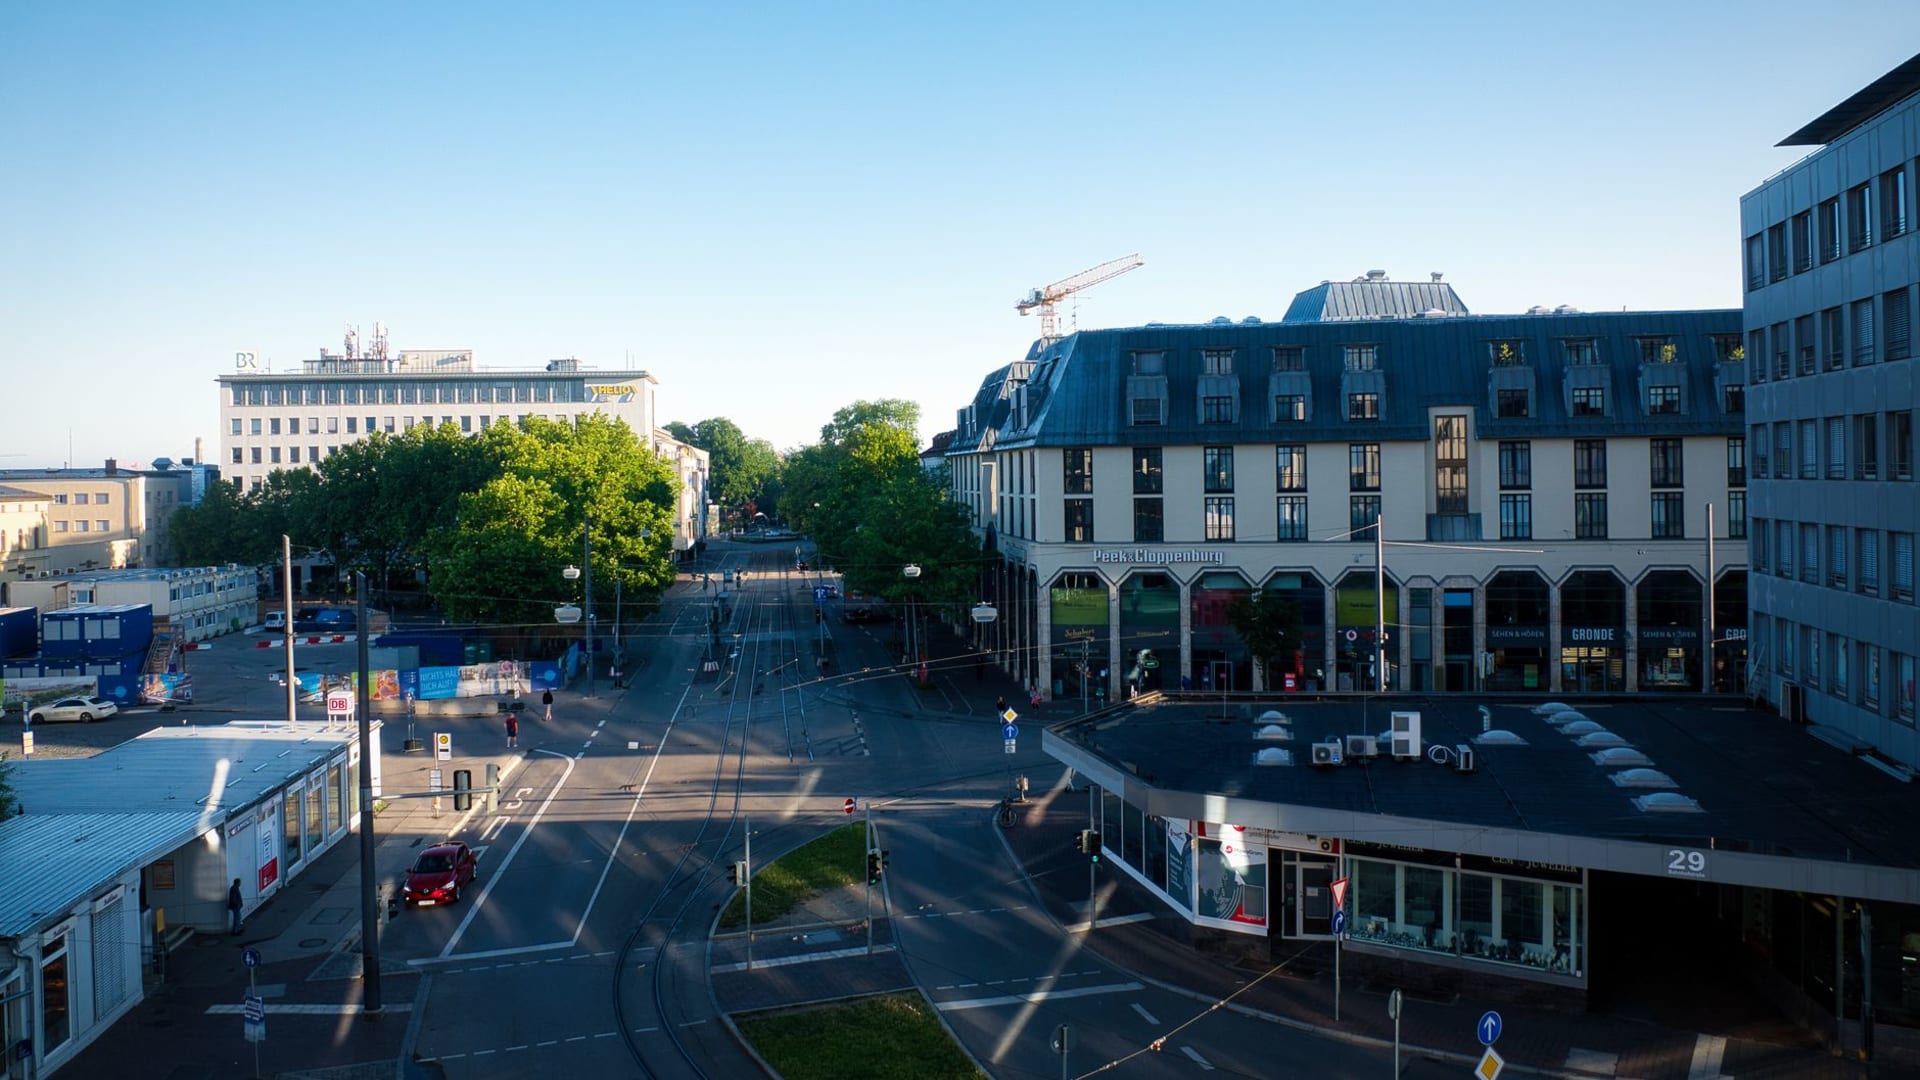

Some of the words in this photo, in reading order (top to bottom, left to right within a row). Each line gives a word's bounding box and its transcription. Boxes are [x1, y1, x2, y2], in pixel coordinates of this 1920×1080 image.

[236, 352, 256, 368] BR
[1491, 630, 1514, 638] SEHEN
[1572, 627, 1615, 642] GRONDE
[331, 700, 345, 709] DB
[1669, 850, 1705, 871] 29
